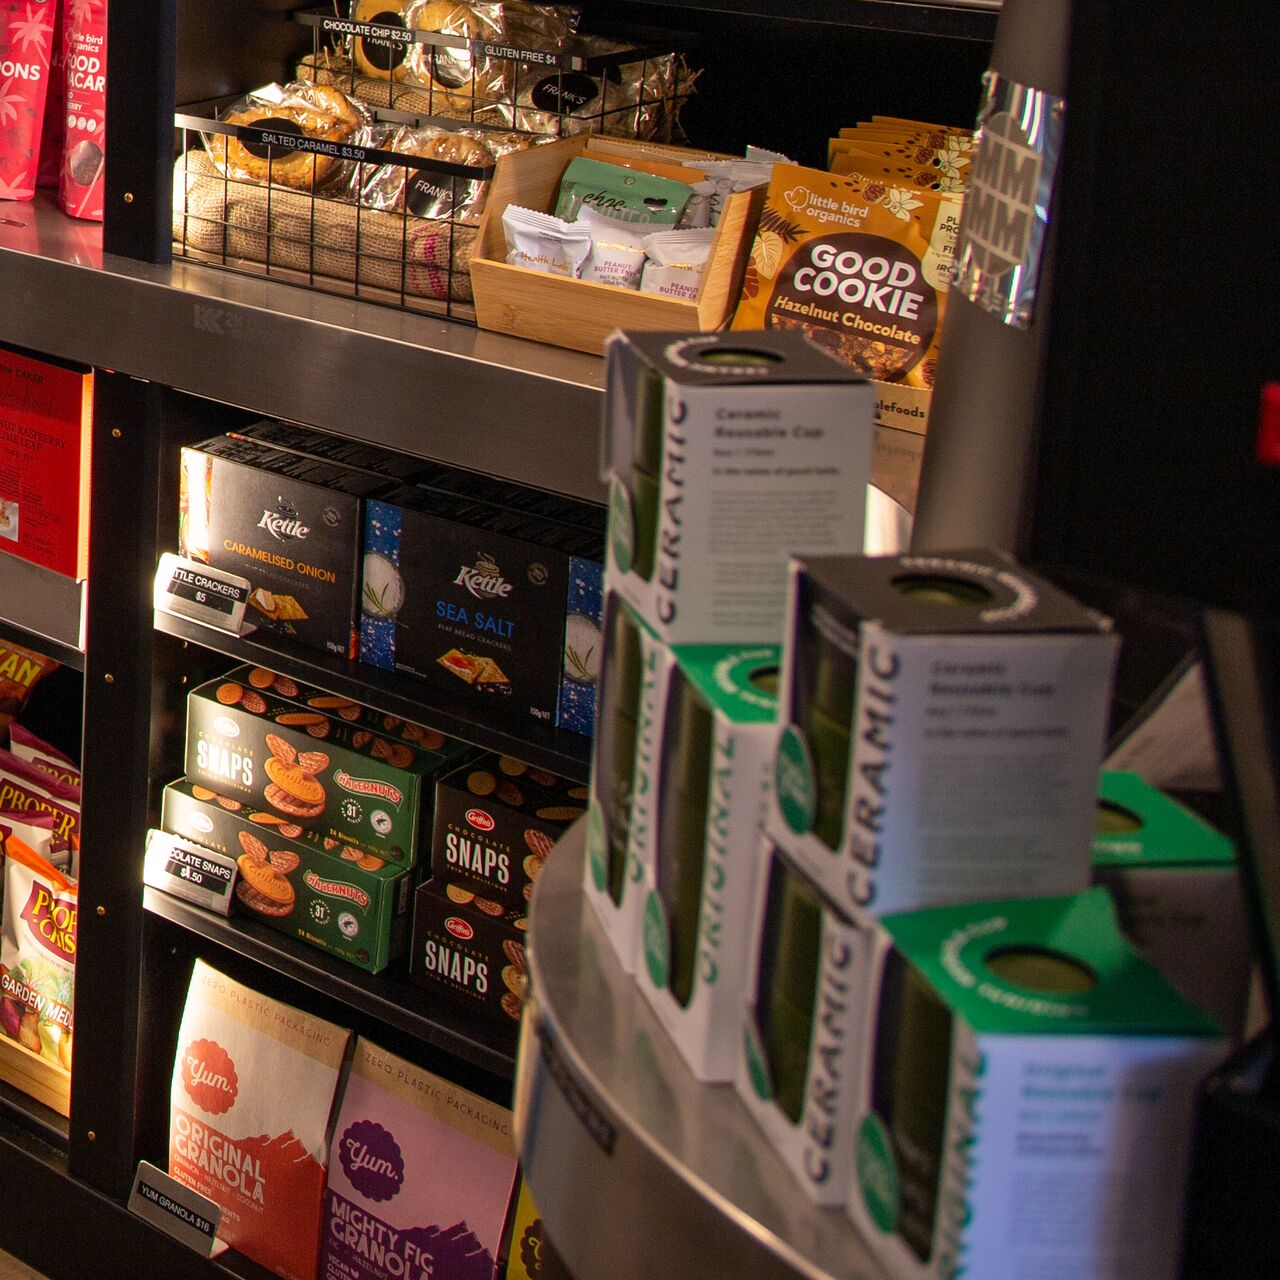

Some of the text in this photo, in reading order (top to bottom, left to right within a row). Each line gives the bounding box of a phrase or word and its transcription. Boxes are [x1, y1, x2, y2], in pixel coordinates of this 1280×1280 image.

[323, 20, 412, 42] CHOCOLATE CHIP $2.50
[485, 44, 557, 65] GLUTEN FREE $4
[262, 133, 365, 160] SALTED CARAMEL $3.50
[806, 207, 861, 228] organics
[809, 192, 869, 218] little bird
[811, 244, 917, 288] GOOD
[794, 267, 924, 321] COOKIE
[775, 296, 921, 345] Hazelnut Chocolate
[256, 509, 310, 541] Kettle
[655, 393, 689, 625] CERAMIC
[223, 538, 337, 584] CARAMELISED ONION
[452, 565, 513, 599] Kettle
[194, 590, 207, 603] $5
[435, 600, 515, 639] SEA SALT
[197, 739, 253, 787] SNAPS
[845, 643, 900, 905] CERAMIC
[336, 772, 402, 802] GINGERNUTS
[346, 804, 357, 816] 31
[446, 833, 510, 884] SNAPS
[305, 873, 369, 904] GINGERNUTS
[314, 905, 325, 917] 31
[425, 940, 488, 993] SNAPS
[201, 976, 331, 1047] ZERO PLASTIC PACKAGING
[187, 1056, 234, 1094] Yum.
[365, 1053, 508, 1135] ZERO PLASTIC PACKAGING
[174, 1114, 266, 1184] ORIGINAL
[174, 1135, 264, 1205] GRANOLA
[346, 1139, 399, 1180] Yum.
[141, 1185, 210, 1233] YUM GRANOLA $16
[331, 1196, 433, 1271] MIGHTY FIG
